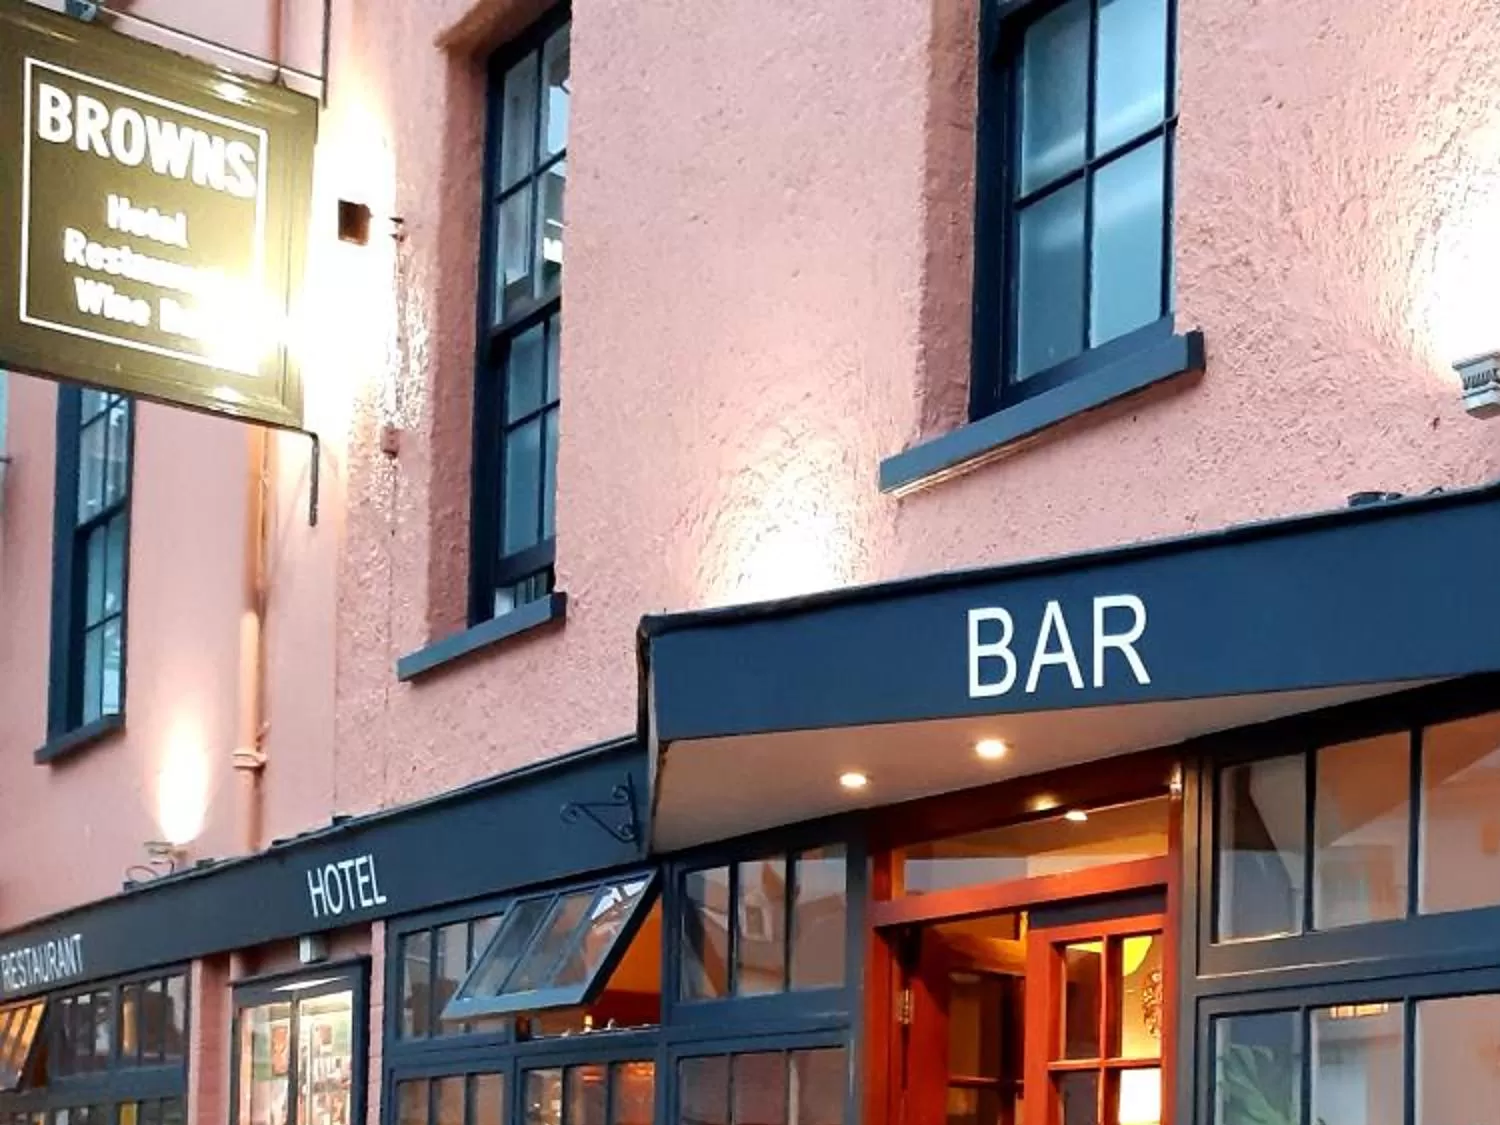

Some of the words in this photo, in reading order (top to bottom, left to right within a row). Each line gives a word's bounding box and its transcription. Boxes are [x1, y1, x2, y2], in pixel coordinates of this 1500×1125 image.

[37, 82, 257, 198] BROWNS
[967, 594, 1152, 699] BAR
[306, 853, 388, 919] HOTEL
[0, 932, 84, 992] RESTAURANT
